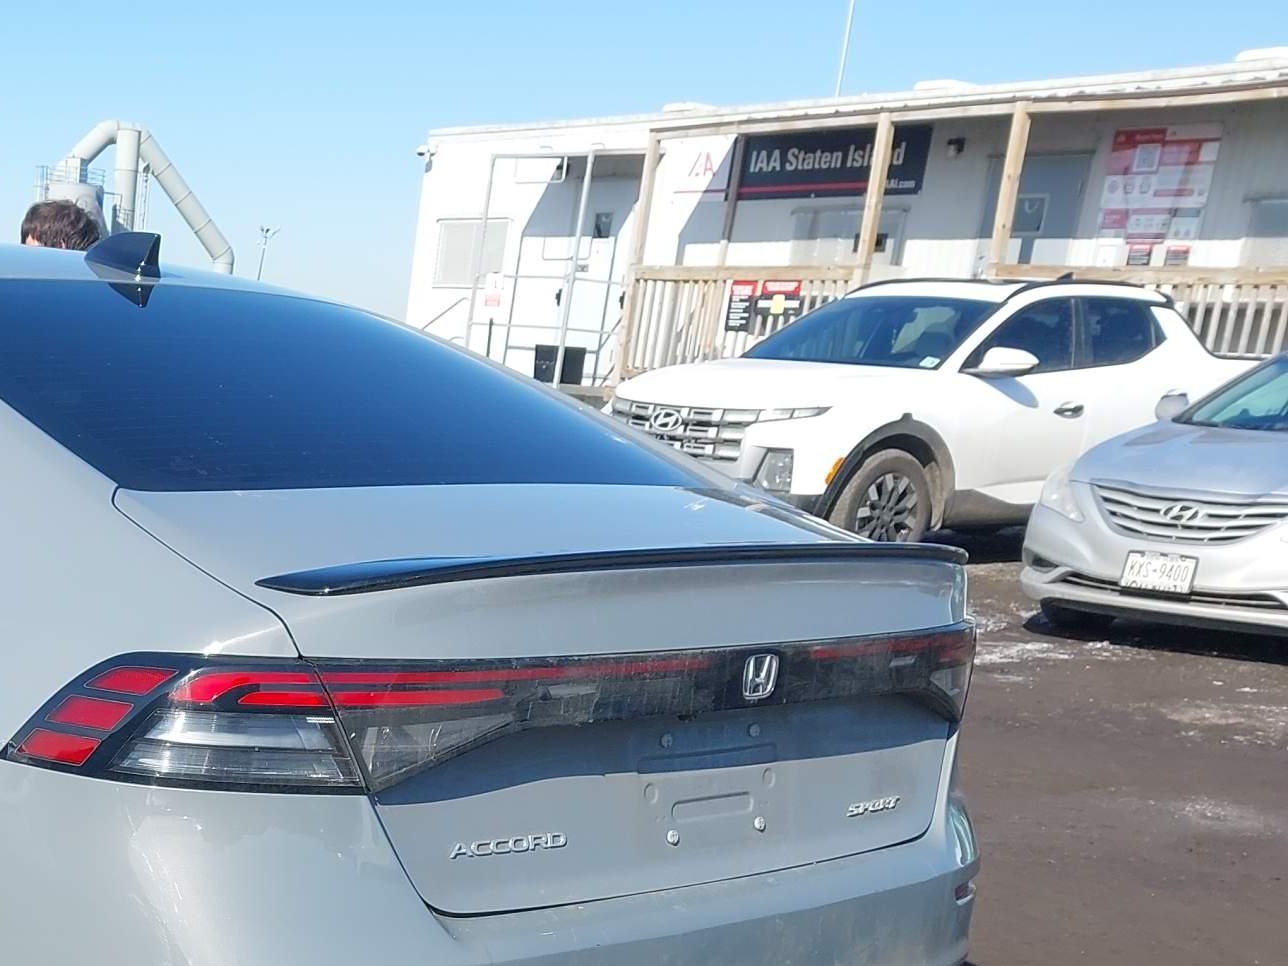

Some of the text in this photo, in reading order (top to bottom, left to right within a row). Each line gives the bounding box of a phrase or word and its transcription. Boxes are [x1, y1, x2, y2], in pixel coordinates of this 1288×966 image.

[750, 142, 906, 172] IAA Staten Isld
[846, 795, 900, 817] SPORT
[449, 832, 568, 860] ACCORD
